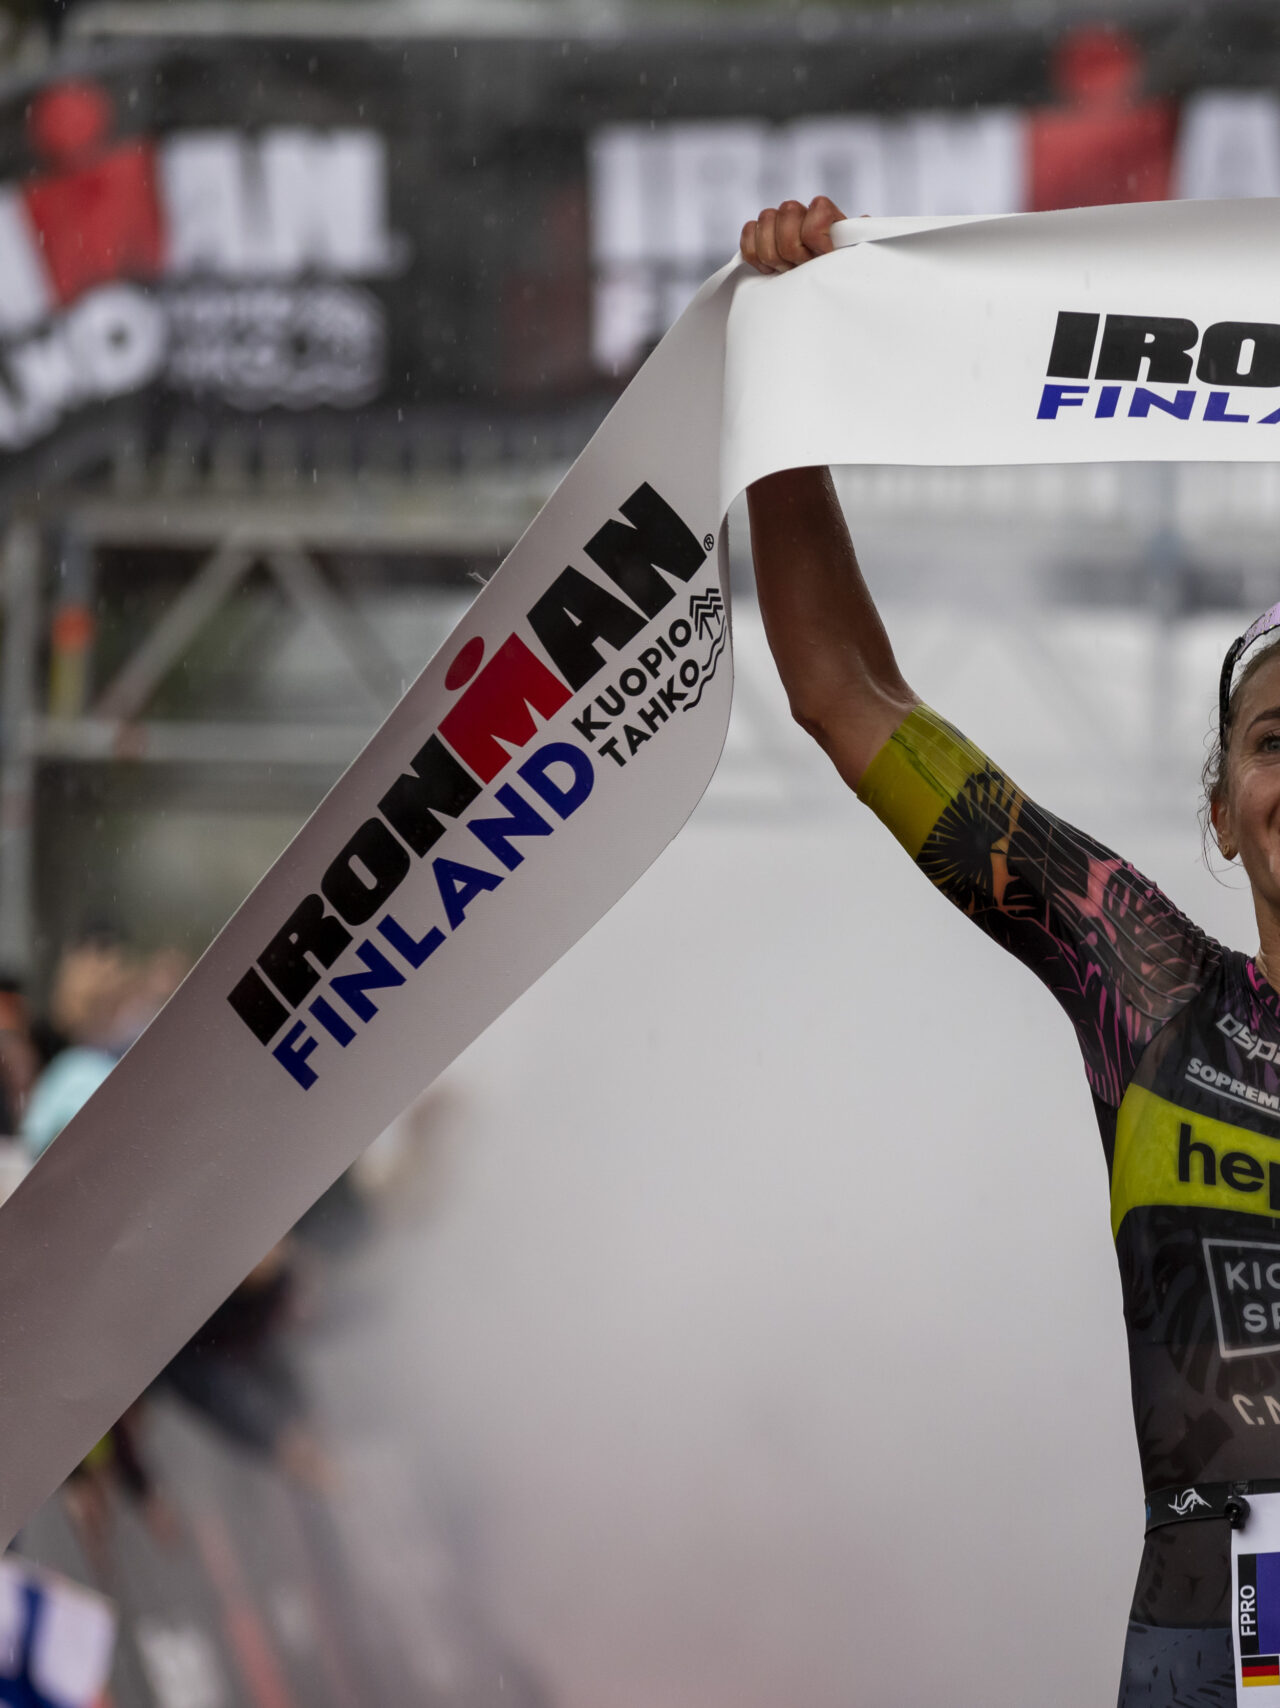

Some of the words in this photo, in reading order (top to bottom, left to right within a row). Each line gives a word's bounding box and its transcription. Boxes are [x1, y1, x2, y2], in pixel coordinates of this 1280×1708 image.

[572, 617, 692, 742] KUOPIO
[597, 662, 700, 768] TAHKO
[227, 481, 708, 1047] IRONMAN
[272, 742, 595, 1091] FINLAND
[1240, 1584, 1257, 1637] FPRO
